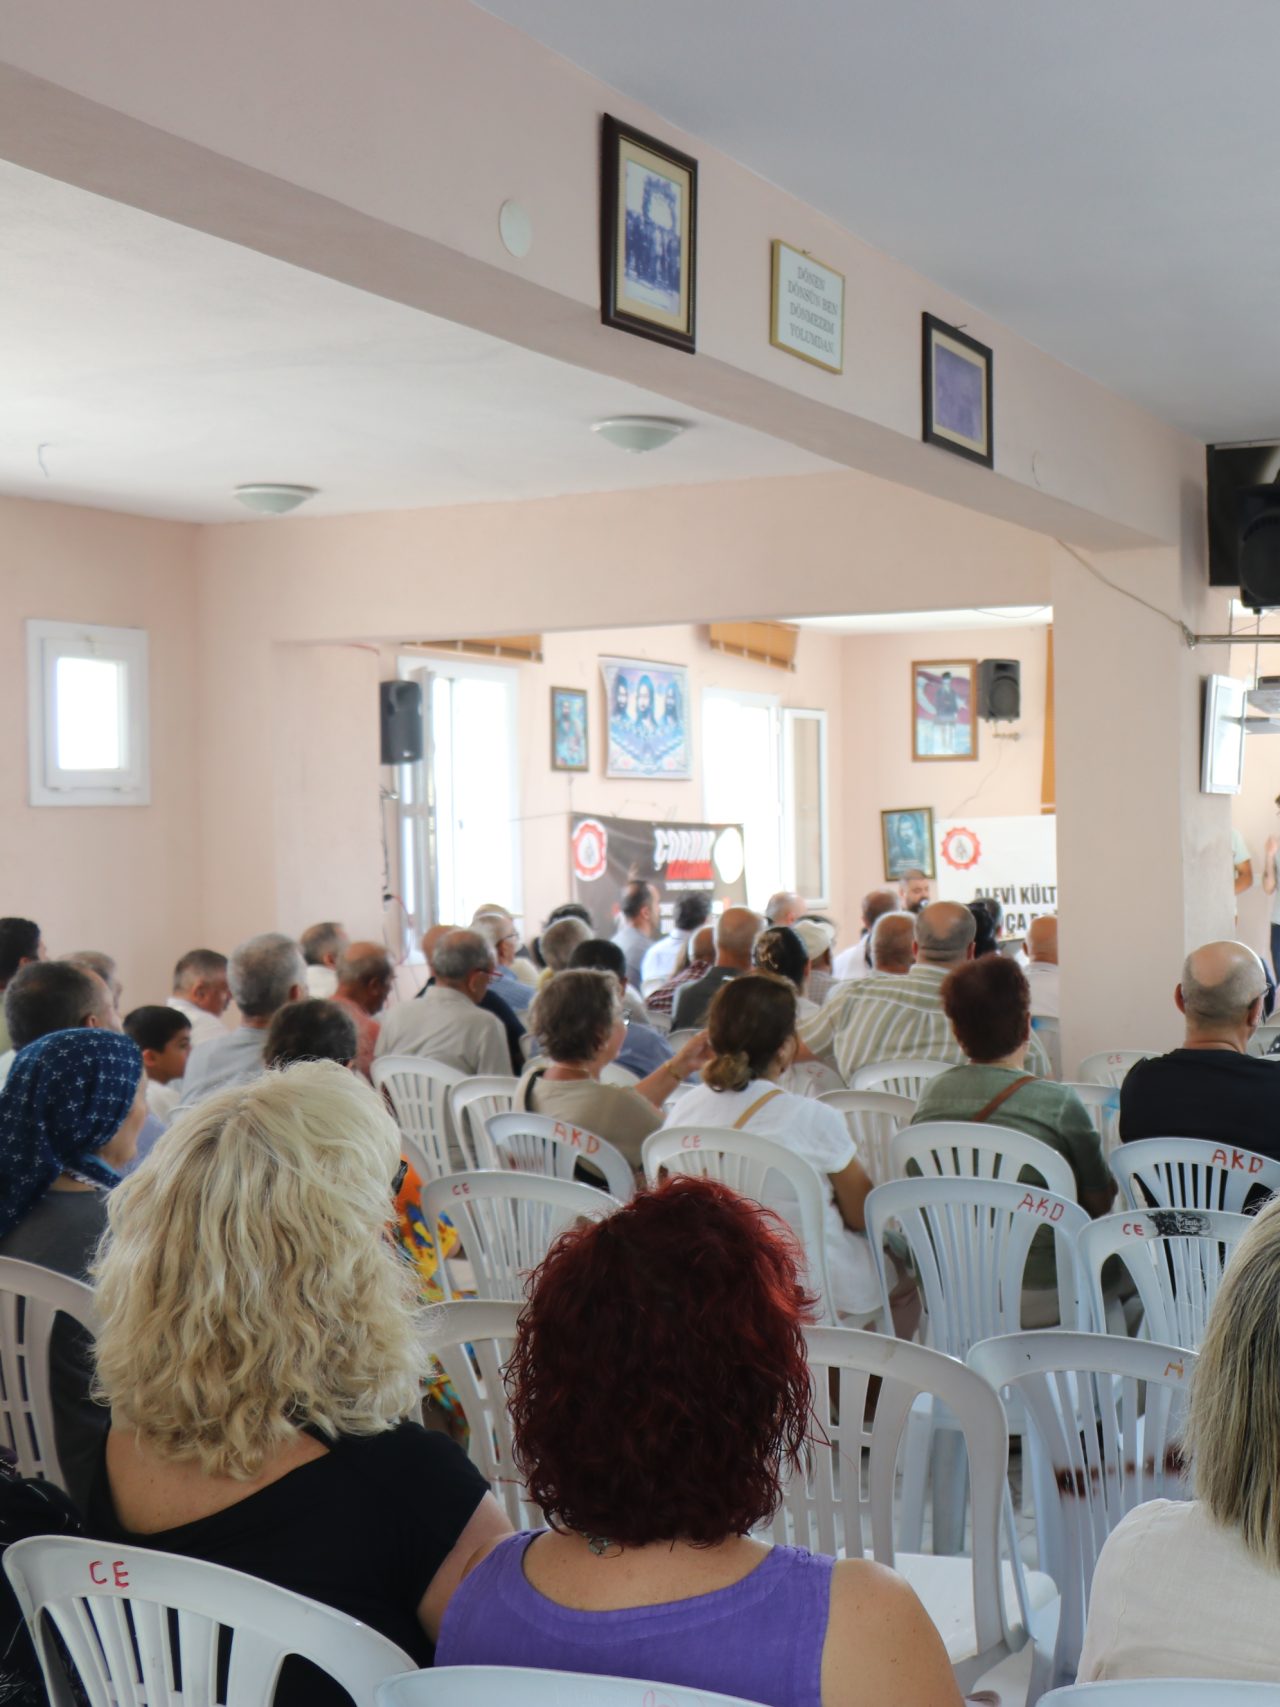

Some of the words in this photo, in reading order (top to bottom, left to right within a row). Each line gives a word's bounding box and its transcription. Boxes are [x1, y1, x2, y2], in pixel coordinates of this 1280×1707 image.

[798, 266, 826, 291] DÖNEN
[822, 298, 838, 315] BEN
[553, 1122, 600, 1154] AKD
[681, 1135, 701, 1149] CE
[1212, 1148, 1264, 1174] AKD
[452, 1182, 470, 1196] CE
[1017, 1192, 1065, 1222] AKD
[1122, 1223, 1144, 1236] CE
[89, 1560, 129, 1588] CE
